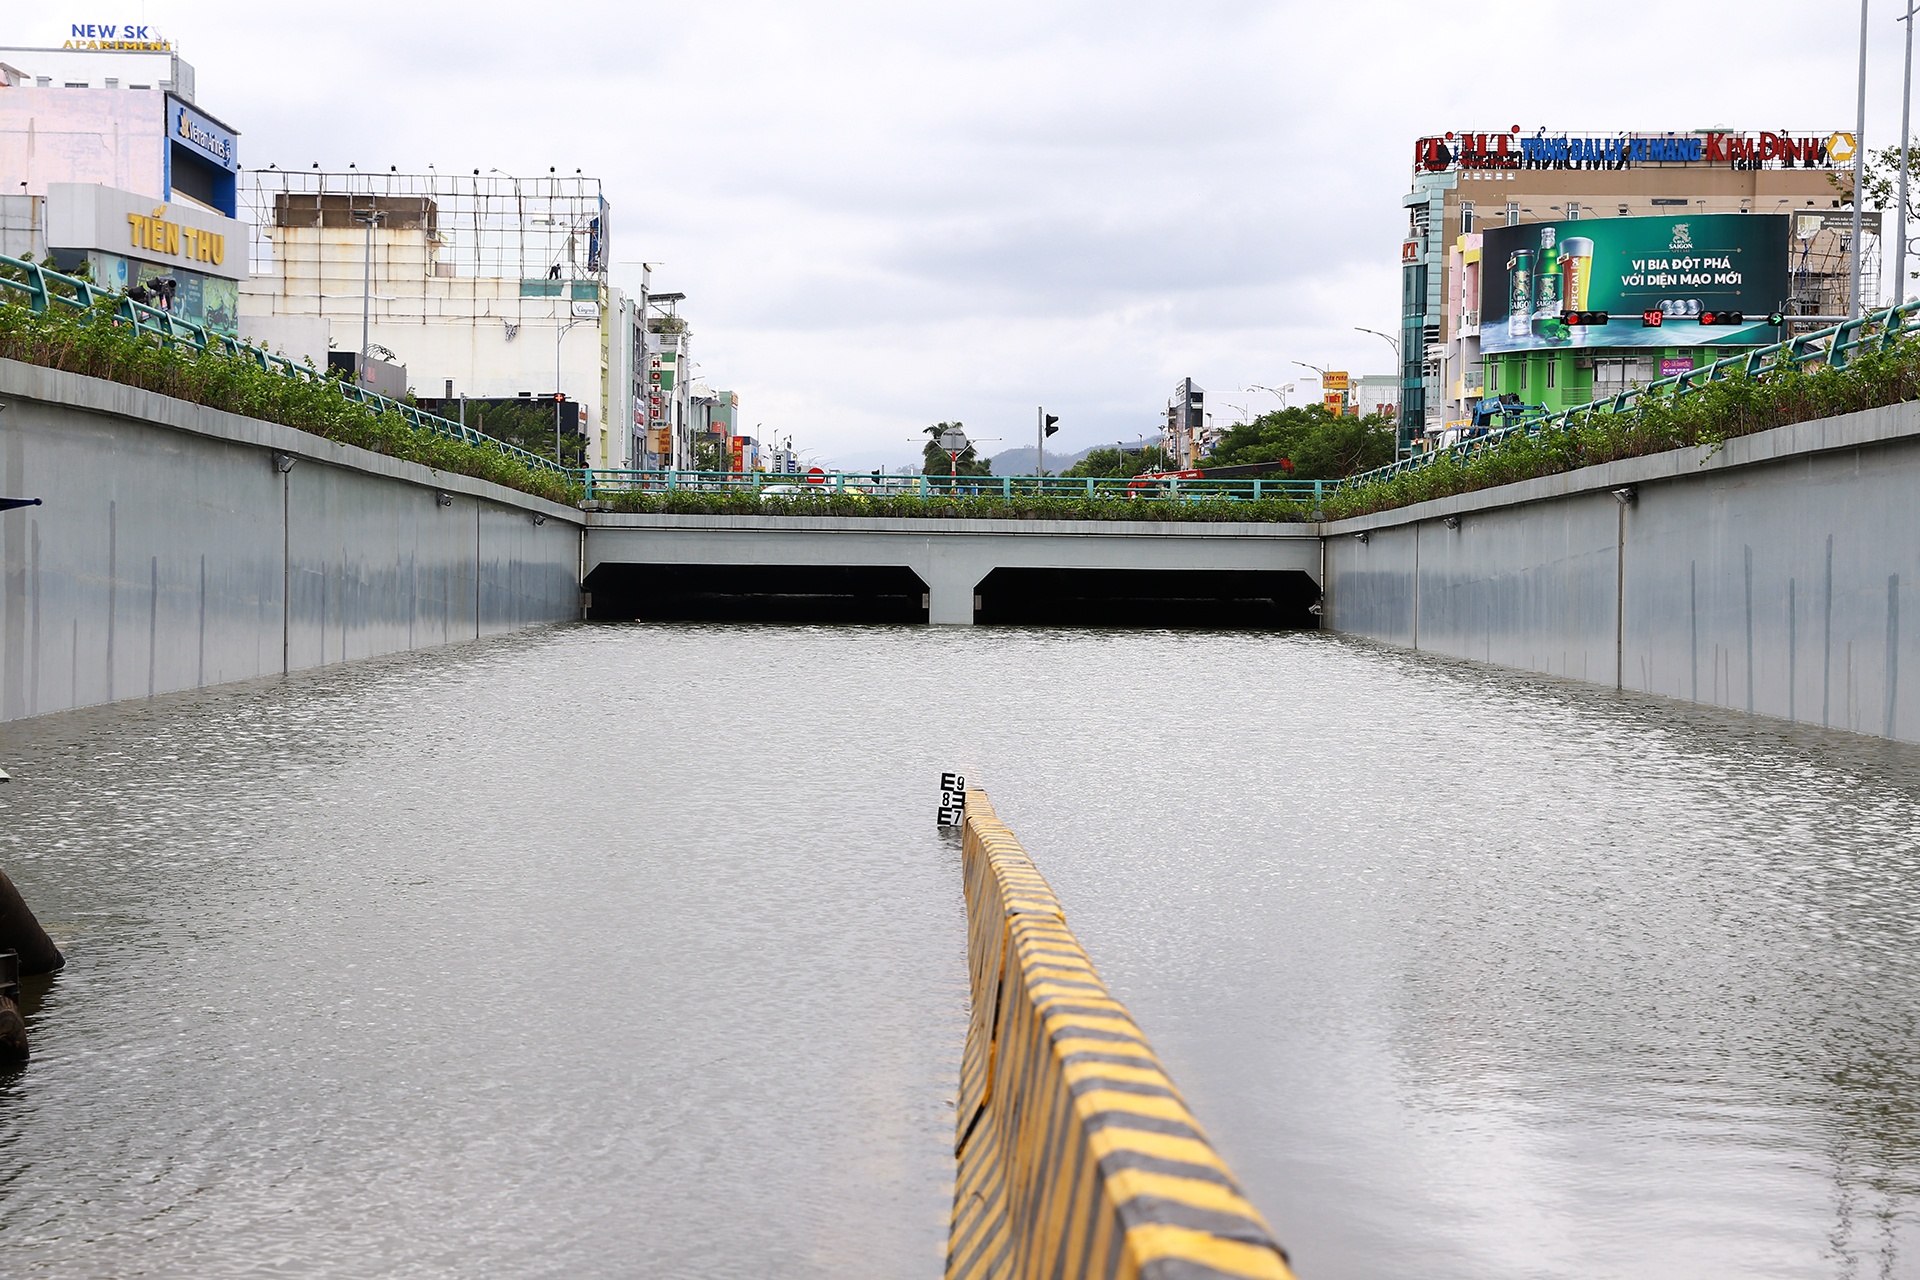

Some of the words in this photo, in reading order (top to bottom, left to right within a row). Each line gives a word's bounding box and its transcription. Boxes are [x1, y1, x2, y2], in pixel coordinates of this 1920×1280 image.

[71, 24, 117, 38] NEW
[62, 39, 172, 51] APARTMENT
[1521, 126, 1568, 161] TỔNG
[1603, 131, 1625, 161] LÝ
[1628, 137, 1648, 161] XI
[1706, 131, 1754, 161] KIM
[1757, 129, 1820, 161] ĐỈNH
[127, 205, 180, 256] TIẾN
[183, 226, 225, 266] THU
[1631, 259, 1645, 273] VỊ
[1647, 258, 1669, 271] BIA
[1671, 255, 1701, 272] ĐỘT
[1703, 255, 1731, 269] PHÁ
[1621, 274, 1644, 286] VỚI
[1647, 272, 1677, 288] DIỆN
[1680, 273, 1711, 288] MẠO
[1714, 271, 1742, 285] MỚI
[1570, 269, 1580, 312] SPECIAL
[1642, 311, 1662, 326] 48
